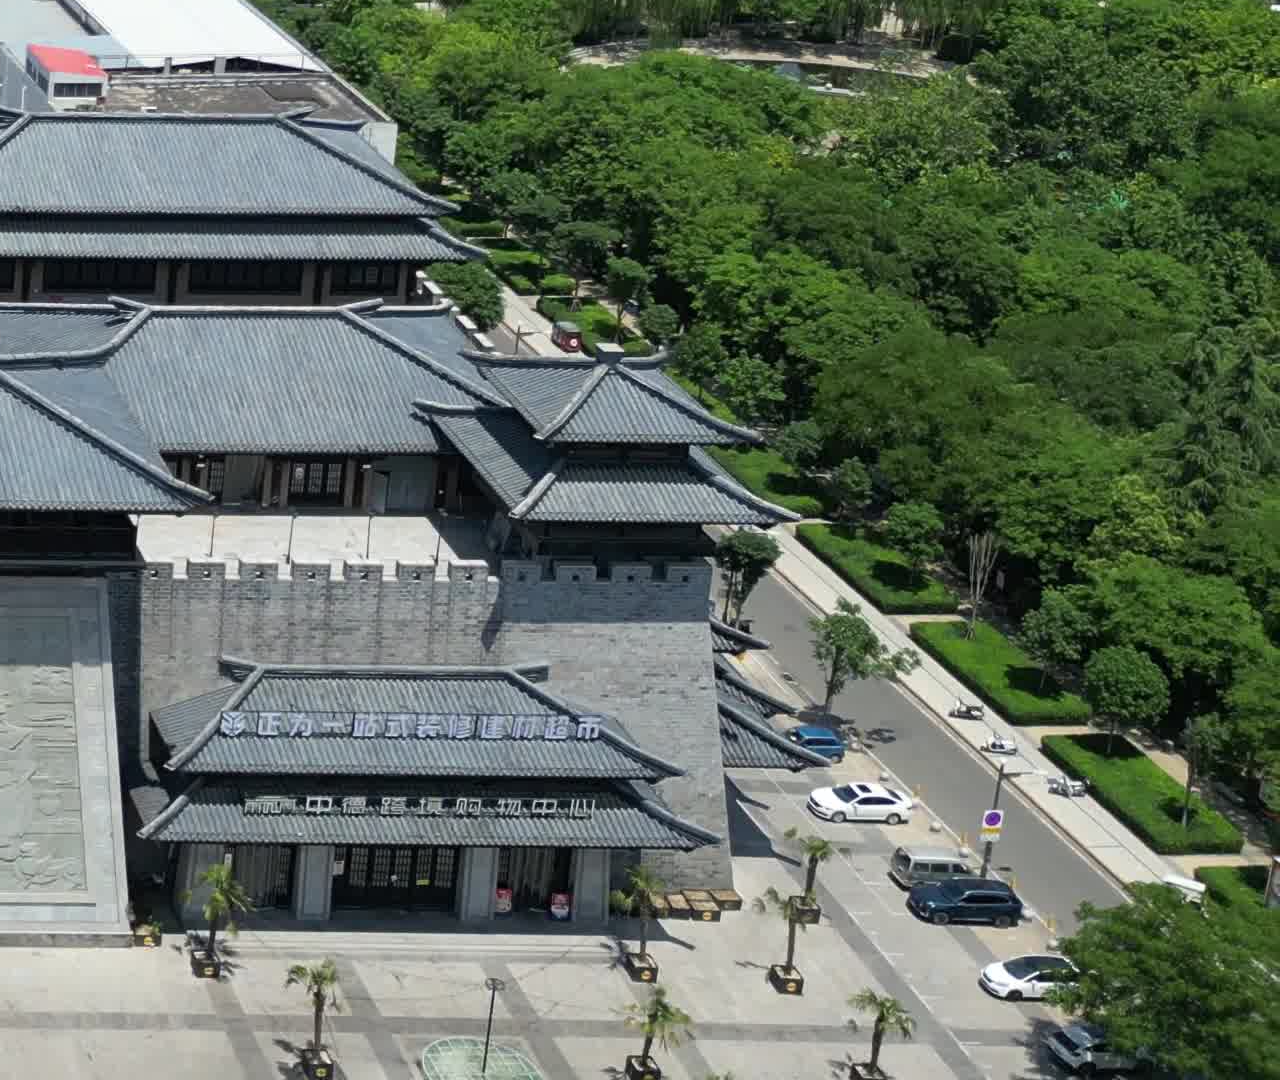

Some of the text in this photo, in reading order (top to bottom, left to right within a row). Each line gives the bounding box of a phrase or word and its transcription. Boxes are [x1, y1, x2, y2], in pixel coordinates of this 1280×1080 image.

[305, 795, 596, 818] 中德跨境购物中心
